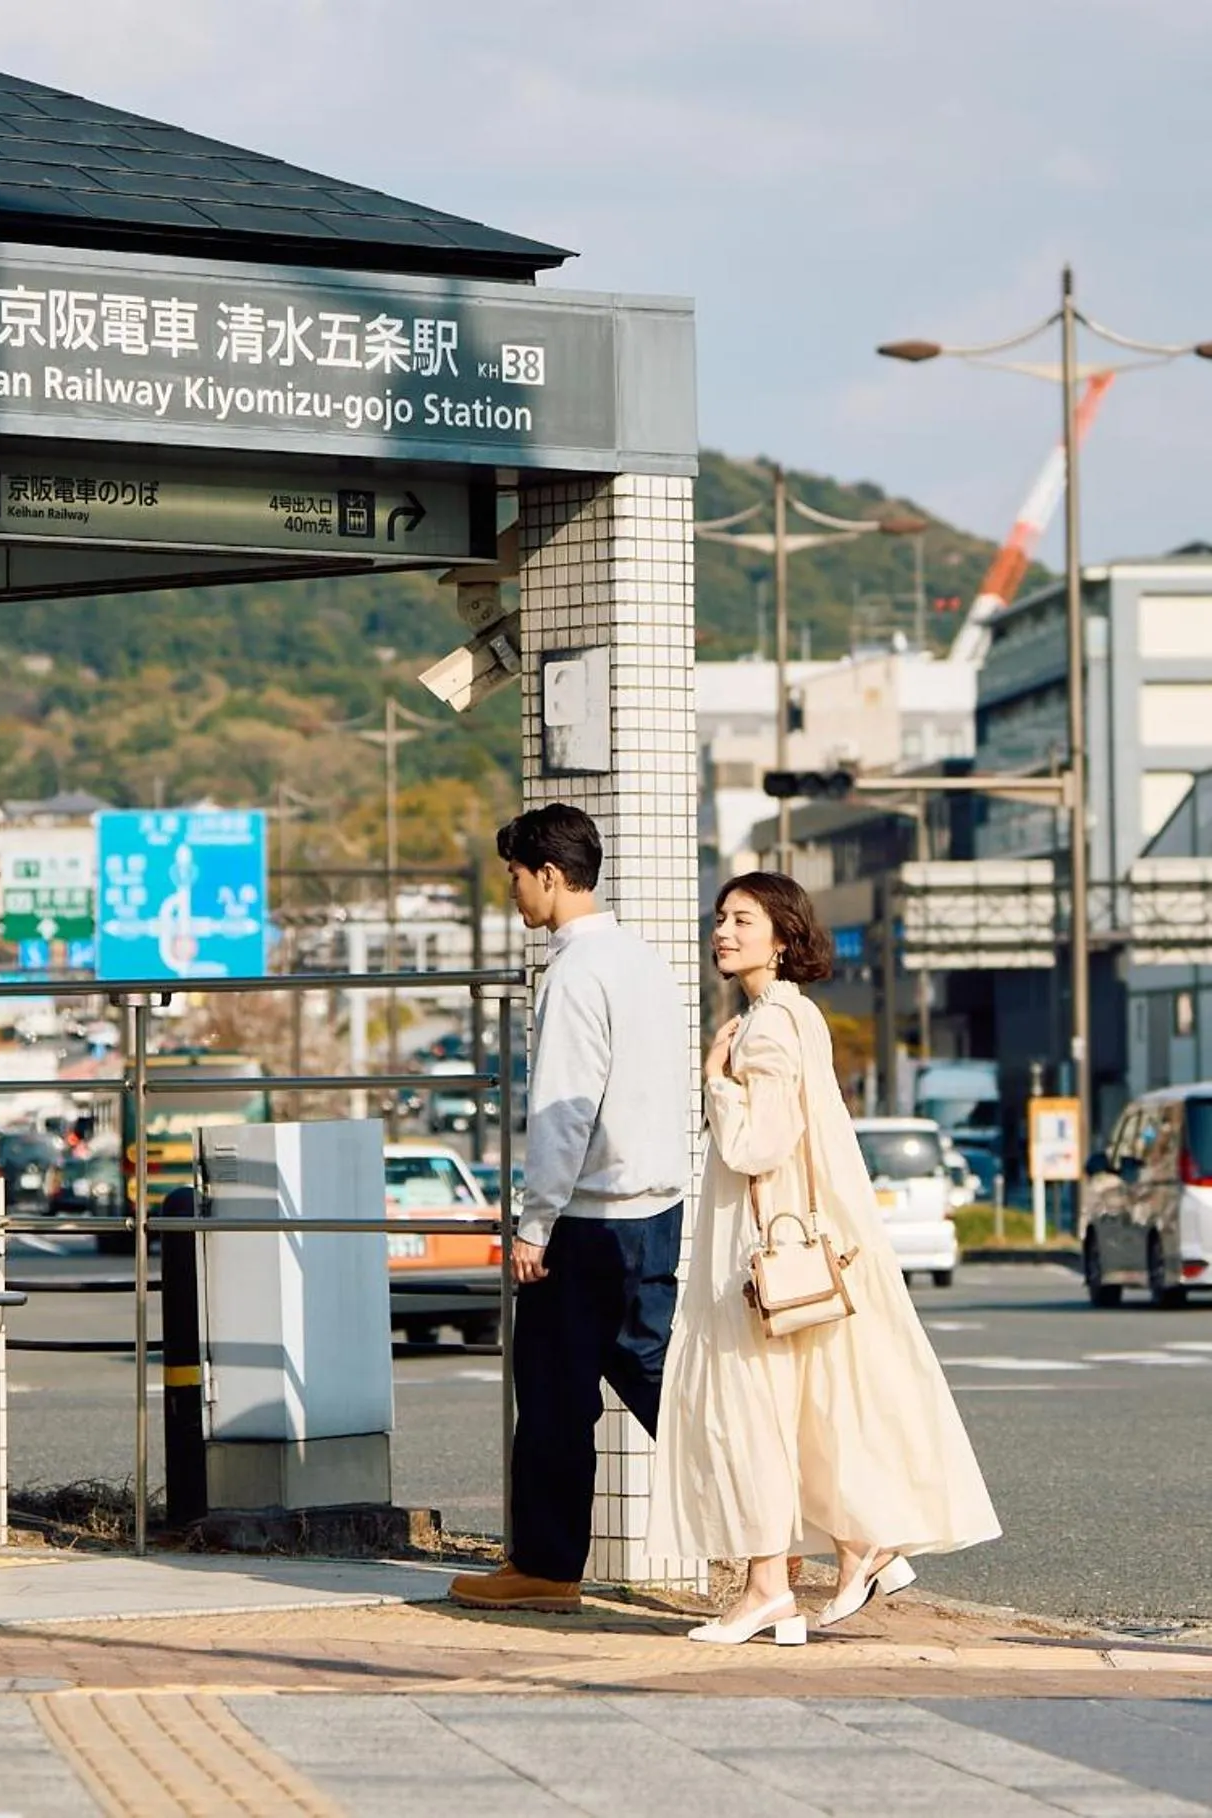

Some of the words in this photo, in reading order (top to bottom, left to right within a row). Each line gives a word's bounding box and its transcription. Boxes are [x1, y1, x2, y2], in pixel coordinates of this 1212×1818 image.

[216, 301, 459, 377] 清水五条駅
[478, 362, 499, 379] KH
[504, 348, 541, 382] 38
[44, 366, 173, 416] Railway
[185, 376, 413, 430] Kiyomizu-gojo
[423, 393, 533, 431] Station
[7, 475, 160, 507] 京阪電車のりば
[269, 495, 332, 514] 4号出入口
[7, 506, 45, 519] Keihan
[48, 508, 90, 524] Railway
[284, 515, 333, 534] 40m先
